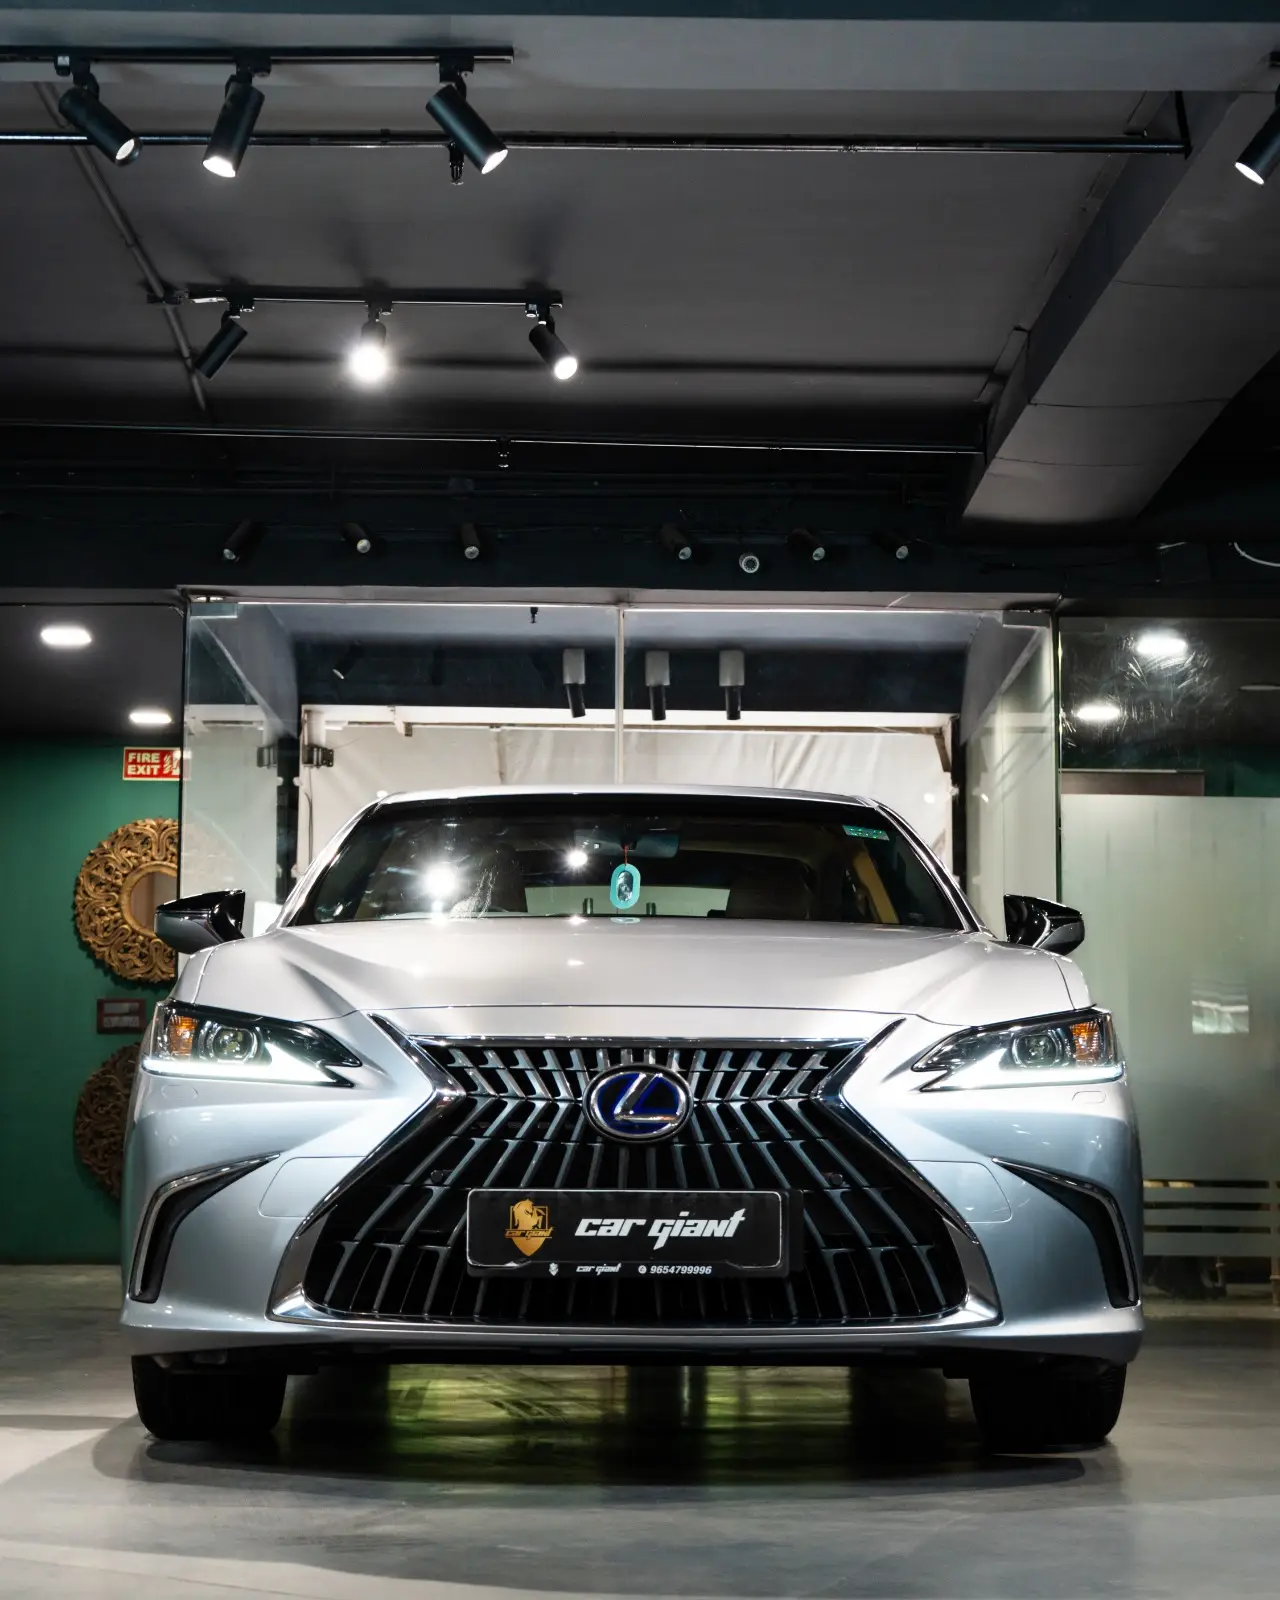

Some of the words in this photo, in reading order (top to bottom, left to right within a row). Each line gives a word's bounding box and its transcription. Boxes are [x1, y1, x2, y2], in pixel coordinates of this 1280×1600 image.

[128, 752, 160, 763] FIRE
[127, 765, 160, 775] EXIT
[574, 1218, 647, 1237] car
[576, 1265, 595, 1273] car
[650, 1265, 712, 1275] 9654799996
